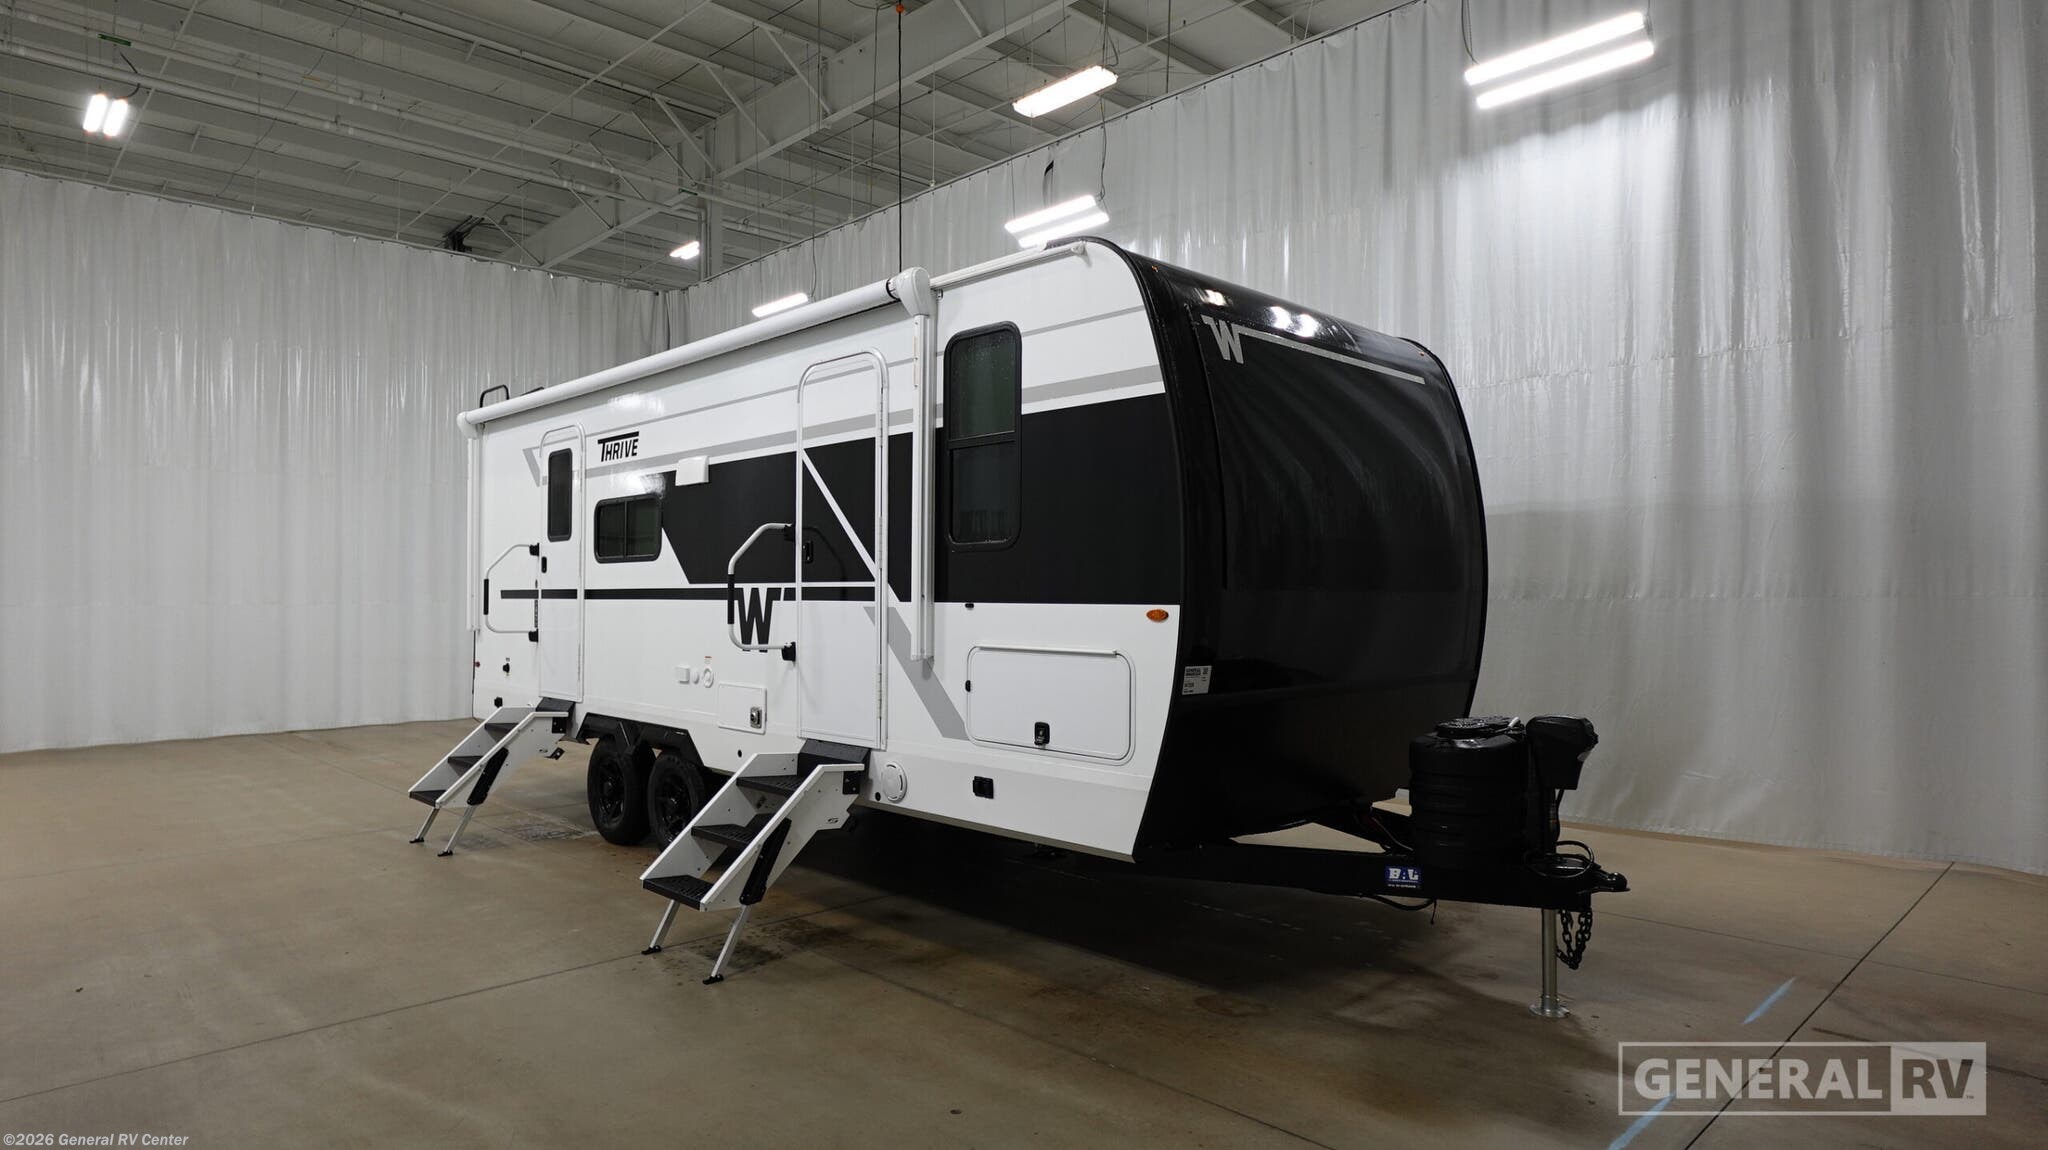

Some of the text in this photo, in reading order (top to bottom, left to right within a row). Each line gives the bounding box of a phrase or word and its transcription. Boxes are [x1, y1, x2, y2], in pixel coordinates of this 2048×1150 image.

[1201, 314, 1244, 364] W
[598, 431, 640, 462] THRIVE
[733, 587, 782, 653] W
